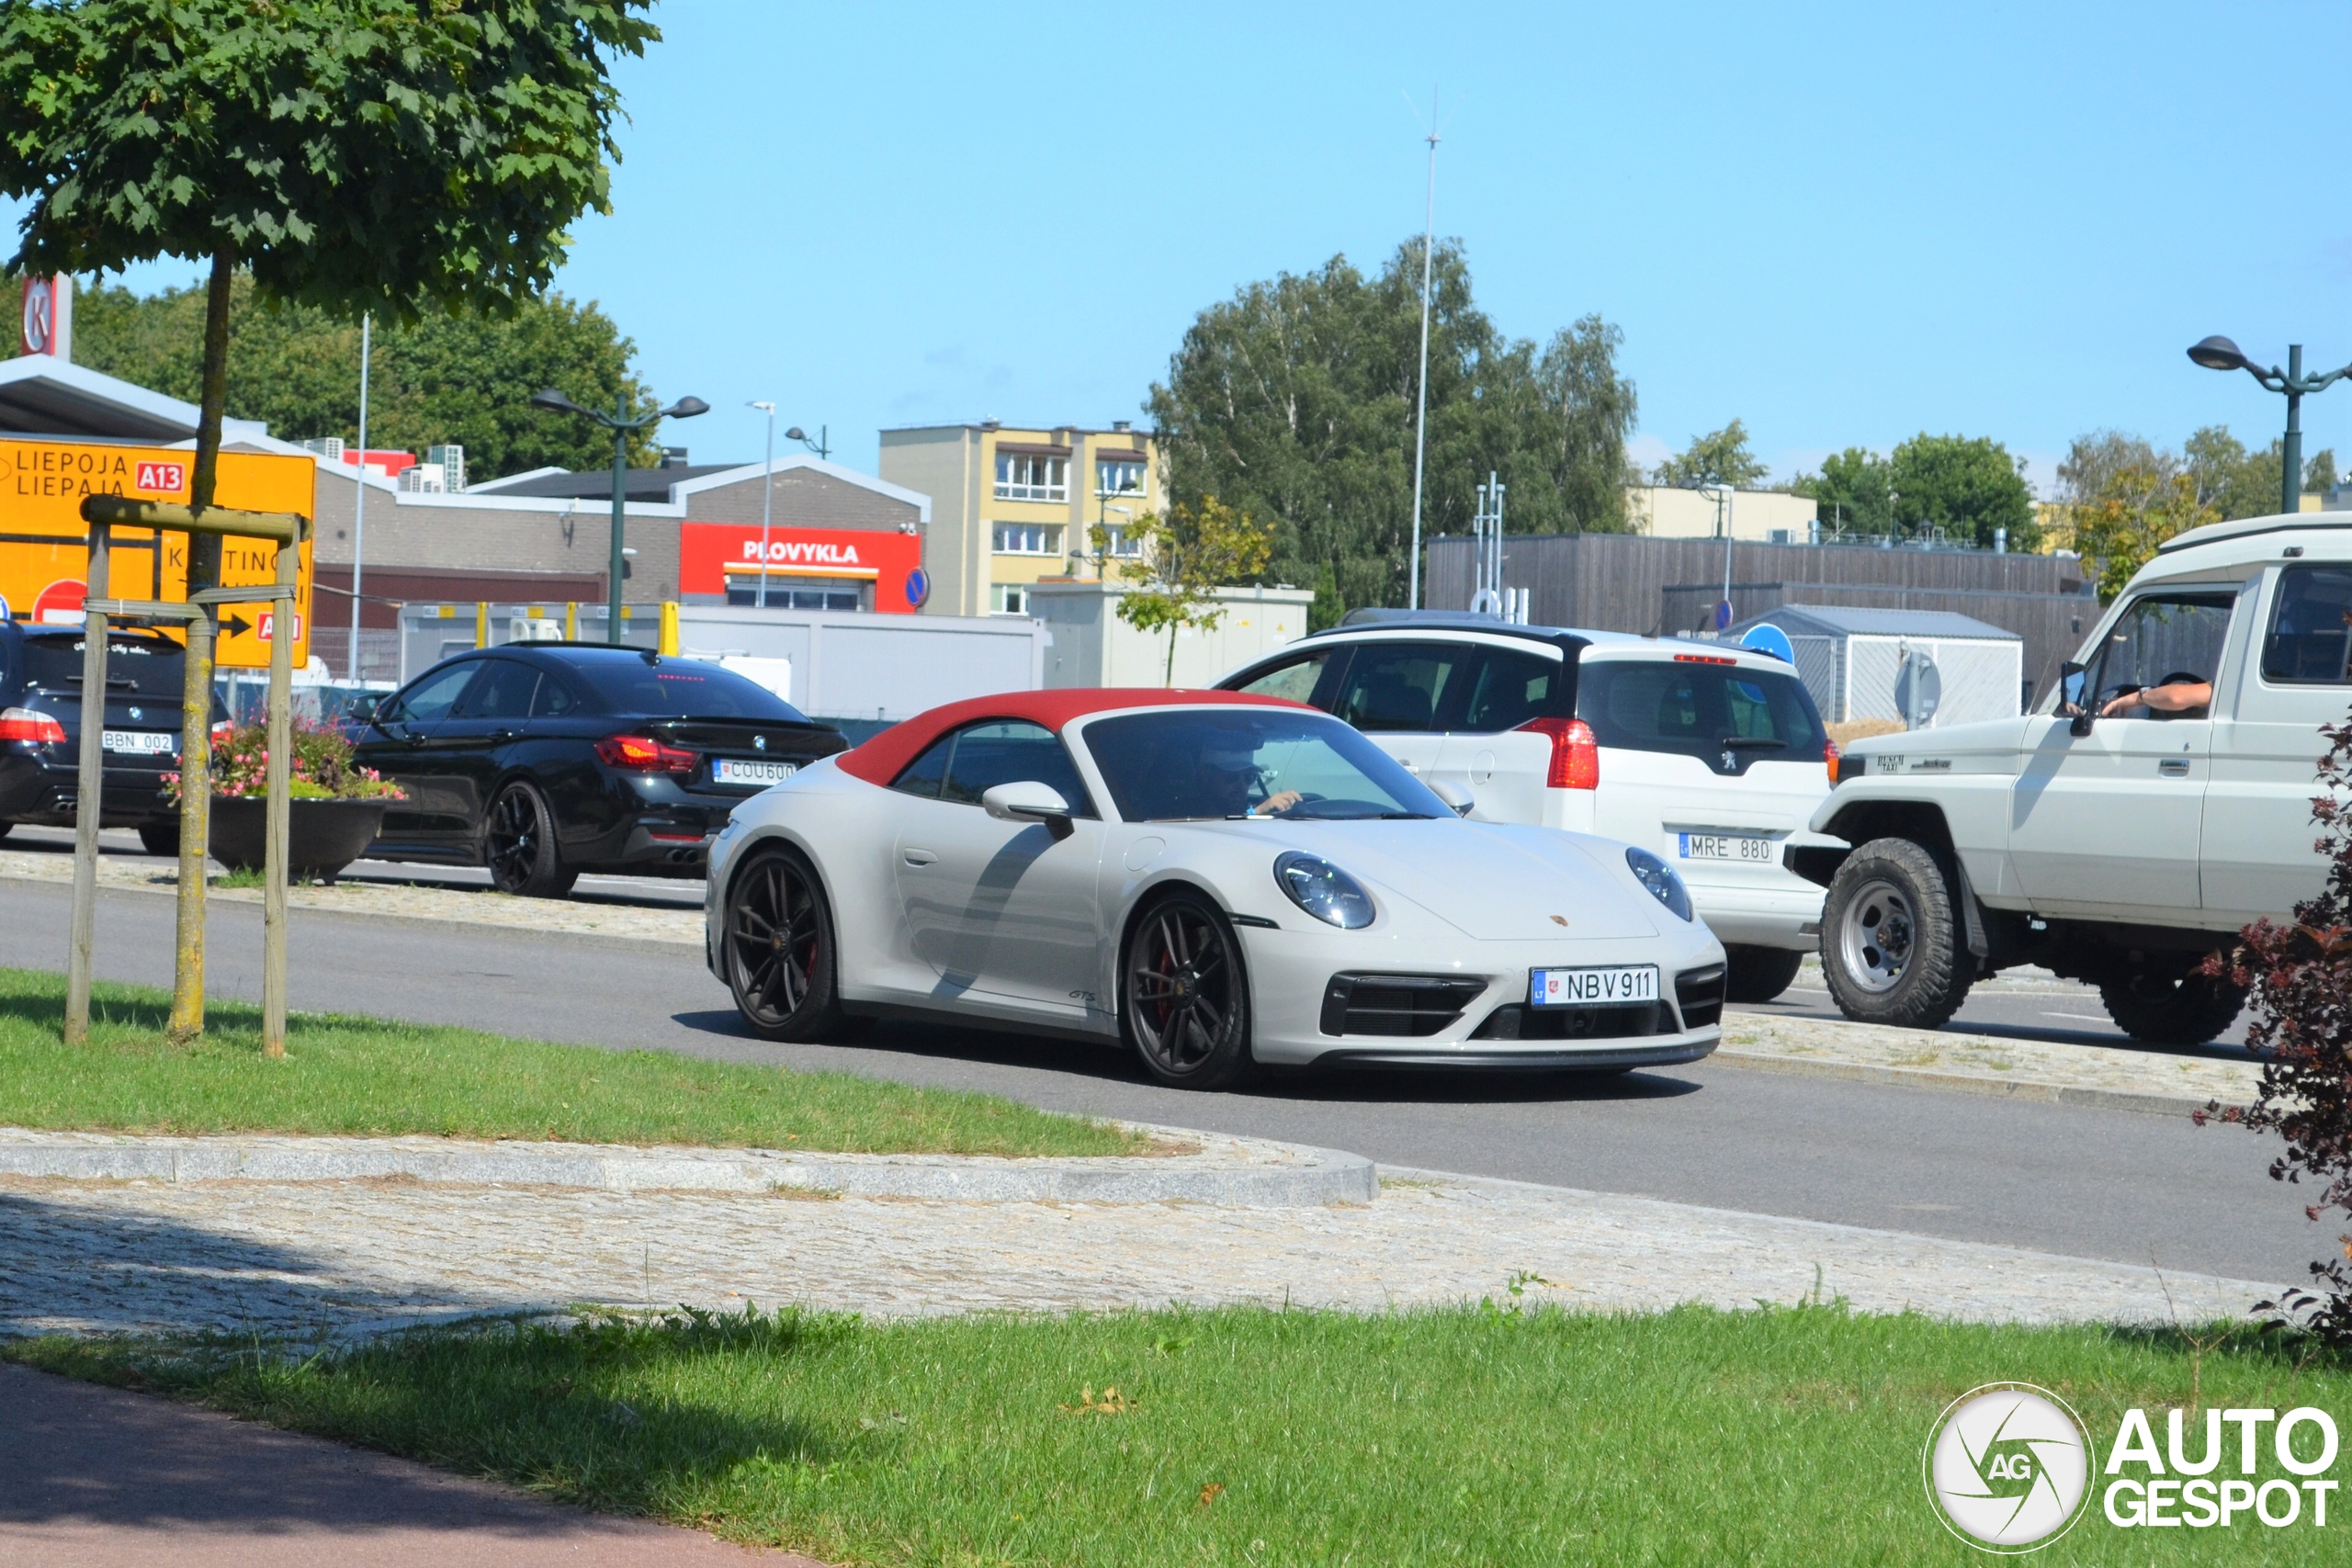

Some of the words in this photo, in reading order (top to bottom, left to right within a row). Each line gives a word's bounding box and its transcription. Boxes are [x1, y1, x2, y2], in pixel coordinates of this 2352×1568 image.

[17, 450, 127, 476] LIEPOJA
[139, 465, 181, 490] A13
[17, 475, 125, 498] LIEPAJA
[742, 540, 860, 564] PLOVYKLA
[105, 733, 135, 749] BBN
[144, 735, 170, 750] 002
[731, 761, 794, 780] COU600
[1691, 836, 1729, 857] MRE
[1741, 839, 1770, 860] 880
[1069, 990, 1096, 1002] GTS
[1535, 990, 1544, 999] LT
